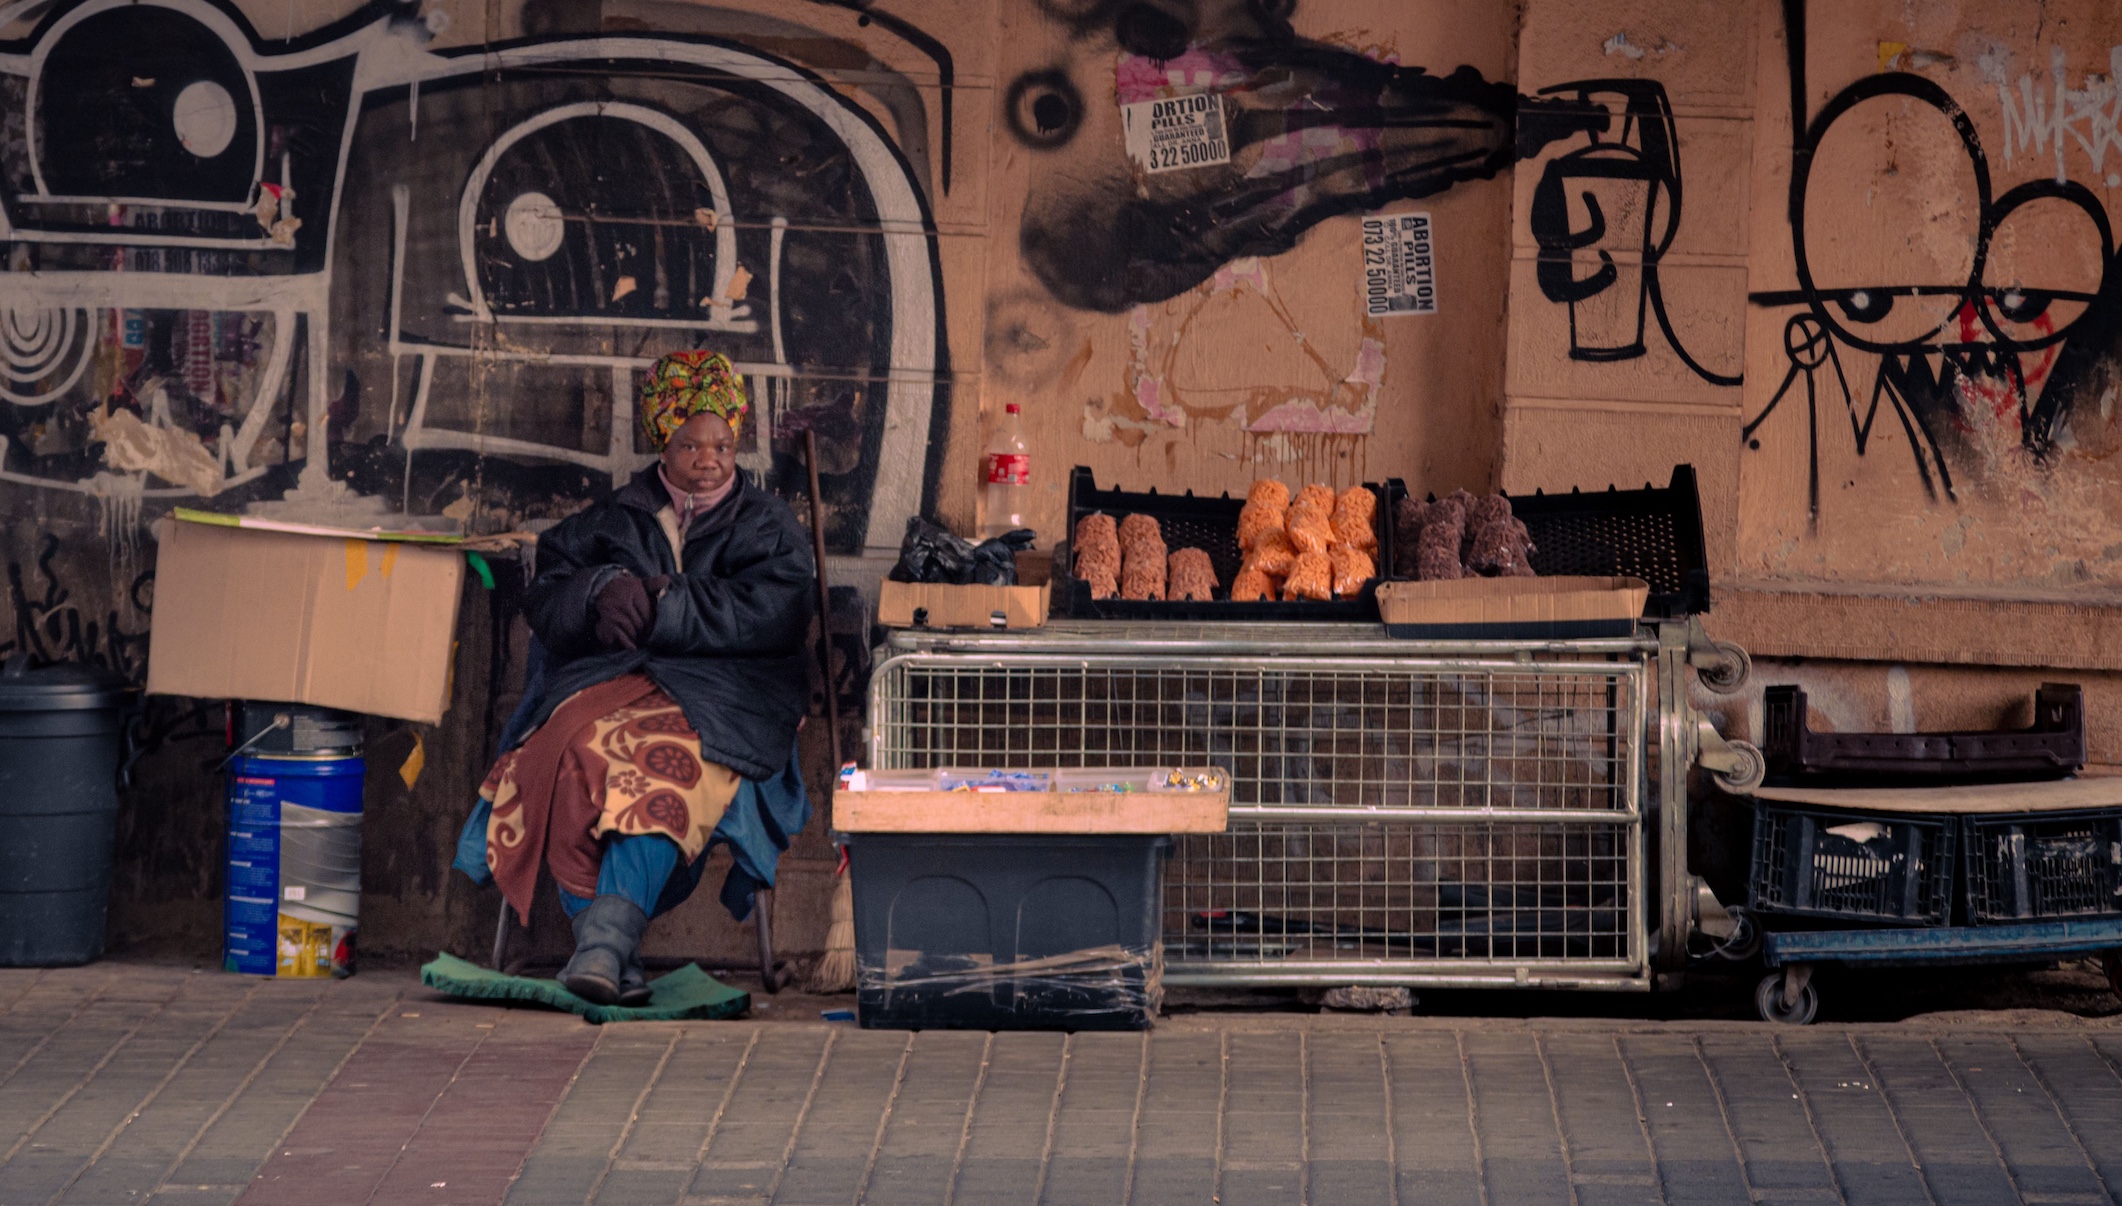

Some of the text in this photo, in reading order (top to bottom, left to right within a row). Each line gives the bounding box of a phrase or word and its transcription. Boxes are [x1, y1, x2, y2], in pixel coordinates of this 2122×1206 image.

[1152, 114, 1196, 129] PILLS
[1153, 128, 1205, 143] GUARANTEED
[1161, 148, 1178, 167] 22
[1181, 140, 1227, 164] 50000
[1363, 221, 1389, 314] 073 22 50000
[1391, 242, 1401, 293] GUARANTEED
[1404, 241, 1415, 285] PILLS
[1412, 217, 1433, 310] ABORTION
